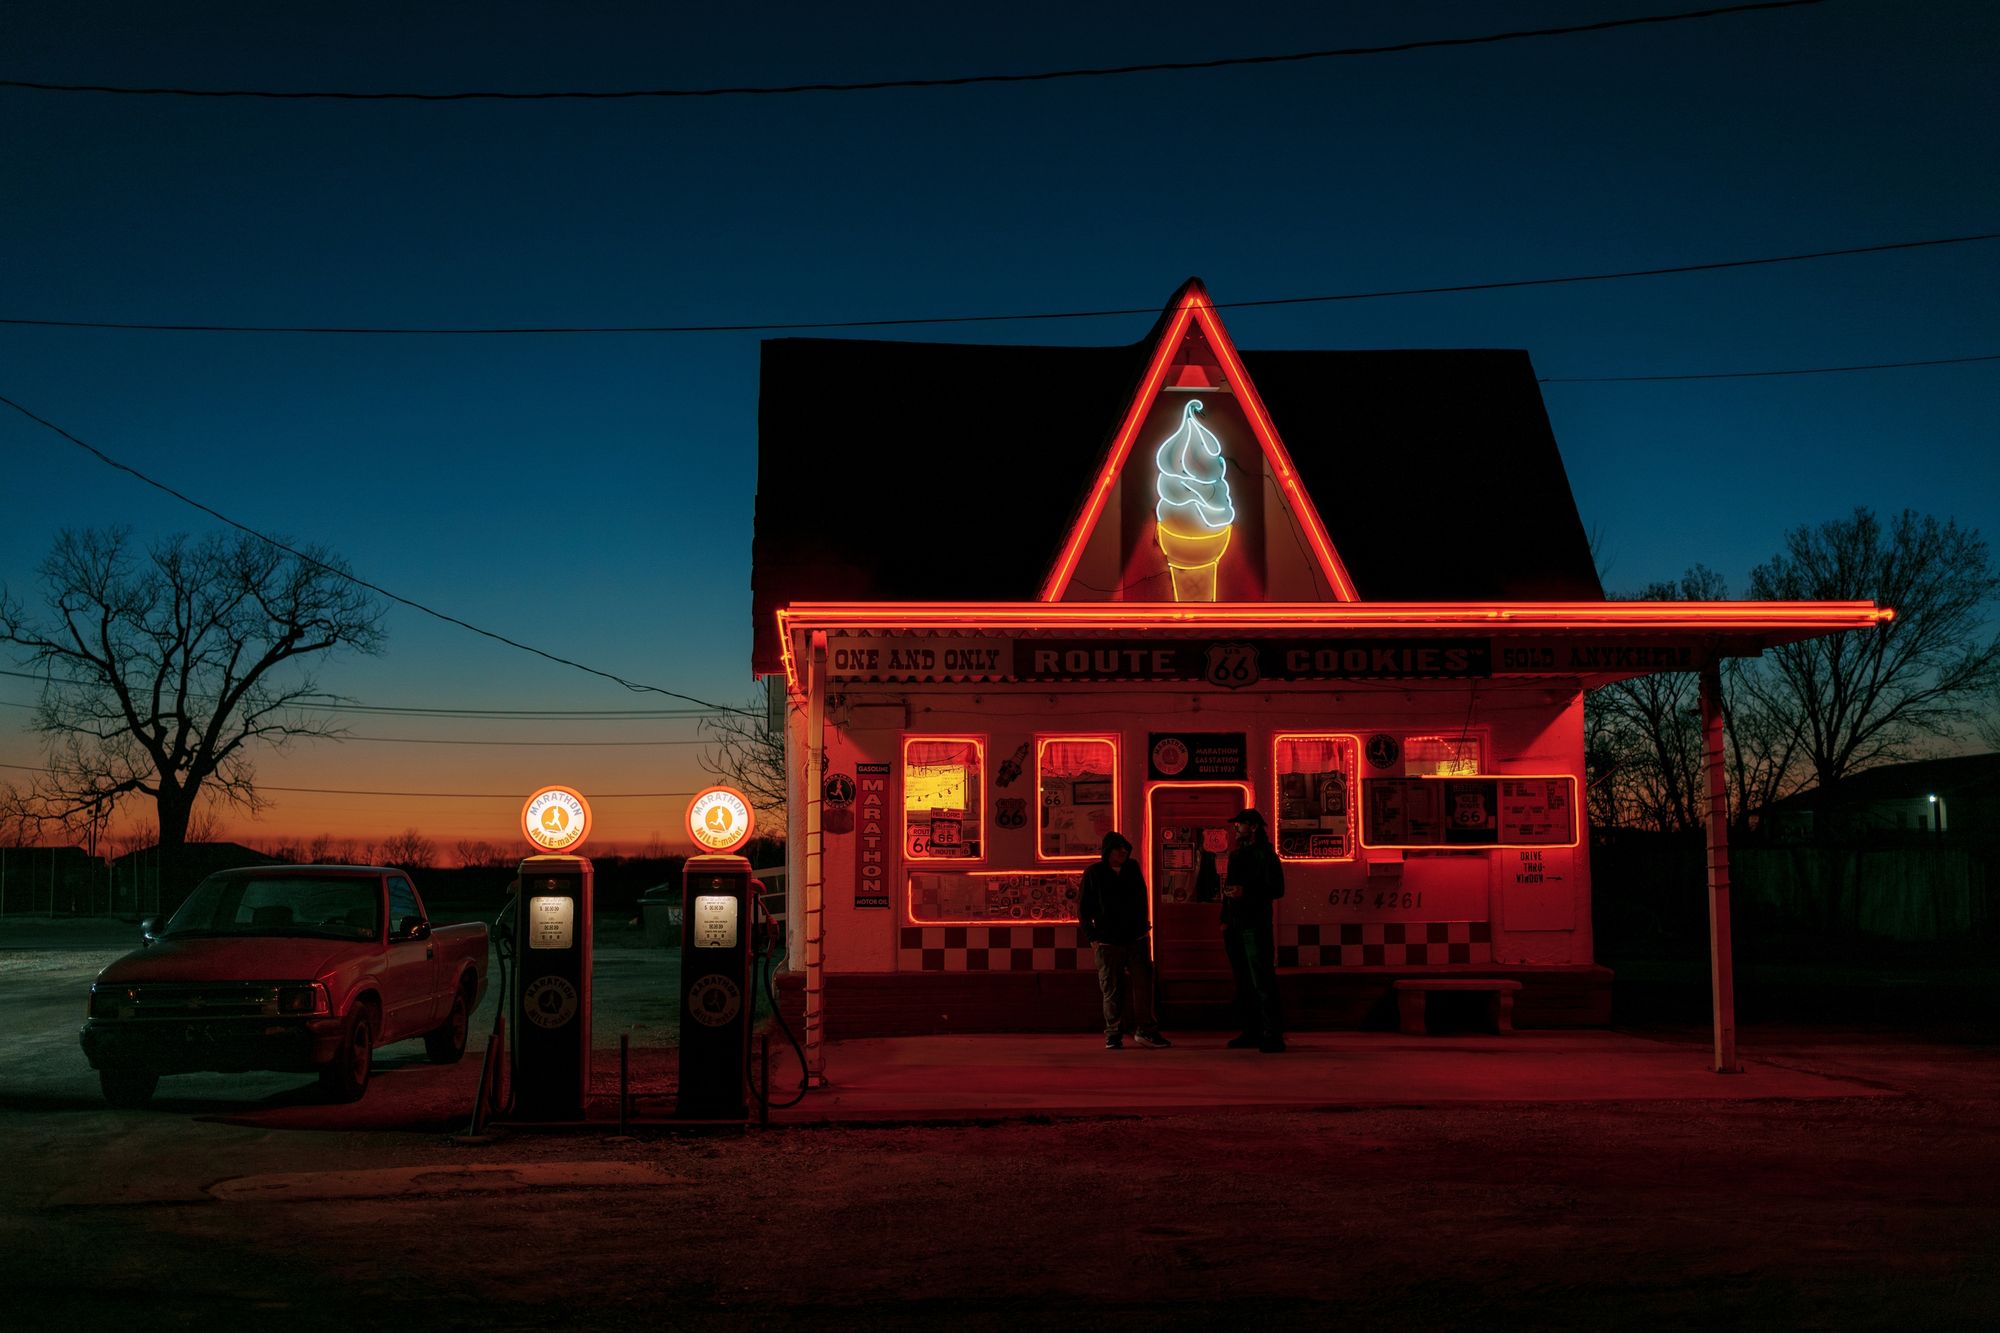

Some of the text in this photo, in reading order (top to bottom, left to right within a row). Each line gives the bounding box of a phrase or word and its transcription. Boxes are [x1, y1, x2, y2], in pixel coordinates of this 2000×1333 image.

[835, 649, 999, 670] ONE AND ONLY
[1035, 650, 1176, 673] ROUTE
[1215, 656, 1248, 681] 66
[1287, 648, 1469, 672] COOKIES
[1503, 647, 1691, 668] SOLD ANYWHERE
[1195, 747, 1239, 755] MARATHON
[1209, 756, 1240, 764] STATION
[530, 792, 582, 816] MARATHON
[694, 792, 746, 816] MARATHON
[999, 809, 1023, 826] 66
[1460, 810, 1481, 823] 66
[531, 826, 580, 847] MILE-maker
[695, 825, 744, 847] MILE-maker
[862, 778, 884, 892] MARATHON
[1313, 847, 1343, 856] CLOSED
[1520, 851, 1543, 861] DRIVE
[1516, 873, 1544, 883] WINDOW
[1328, 888, 1422, 909] 675 4261
[528, 977, 575, 1000] MARATHON
